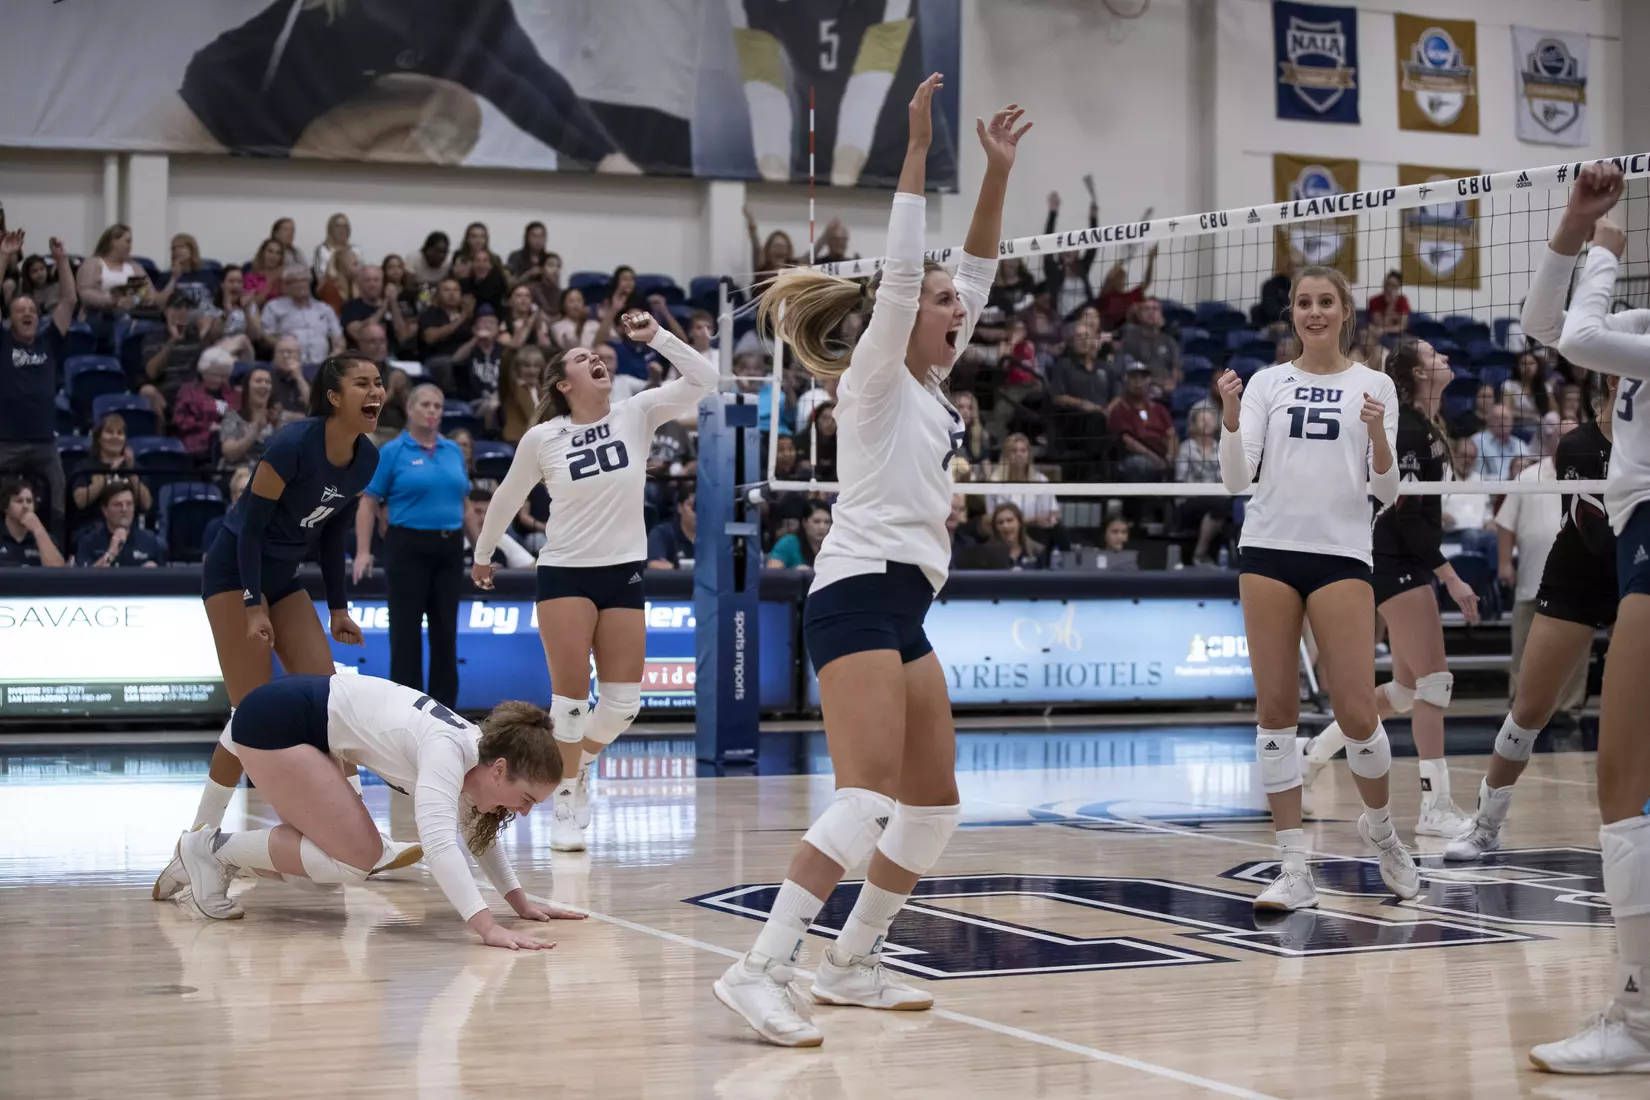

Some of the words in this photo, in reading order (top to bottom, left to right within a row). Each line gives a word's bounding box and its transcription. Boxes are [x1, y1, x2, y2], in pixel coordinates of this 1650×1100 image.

[820, 19, 839, 71] 5
[1291, 34, 1341, 57] NAIA
[999, 241, 1014, 255] BU
[1056, 222, 1150, 248] #LANCEUP
[1199, 211, 1228, 230] CBU
[1279, 188, 1396, 219] #LANCEUP
[1457, 175, 1492, 197] CBU
[1294, 387, 1344, 403] CBU
[571, 423, 611, 447] CBU
[1286, 406, 1342, 441] 15
[566, 440, 629, 481] 20
[300, 505, 335, 528] 11
[0, 605, 146, 628] SAVAGE
[469, 602, 519, 634] by
[734, 610, 745, 650] sports
[733, 651, 745, 700] imports
[946, 663, 1029, 689] YRES
[1043, 661, 1163, 688] HOTELS
